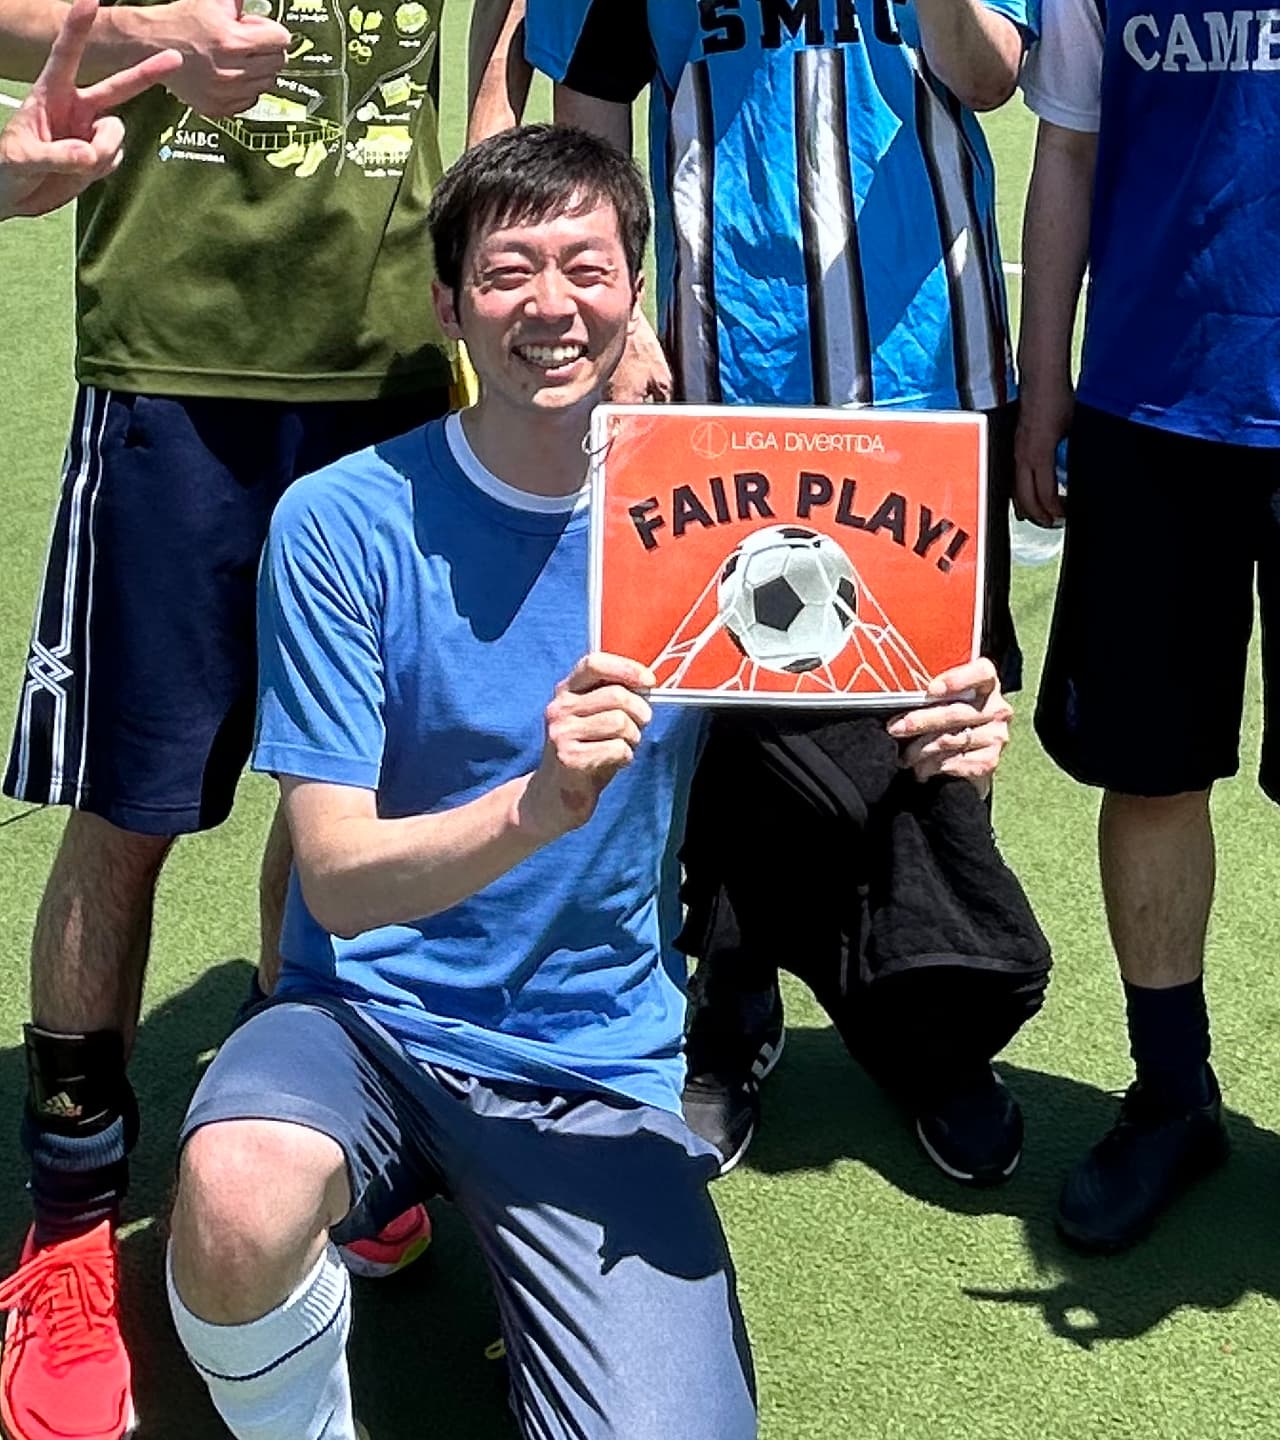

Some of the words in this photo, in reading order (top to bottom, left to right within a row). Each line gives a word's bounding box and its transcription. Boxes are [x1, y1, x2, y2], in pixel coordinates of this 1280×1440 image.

[174, 130, 220, 149] SMBC
[628, 471, 775, 552] FAIR
[796, 470, 971, 574] PLAY!
